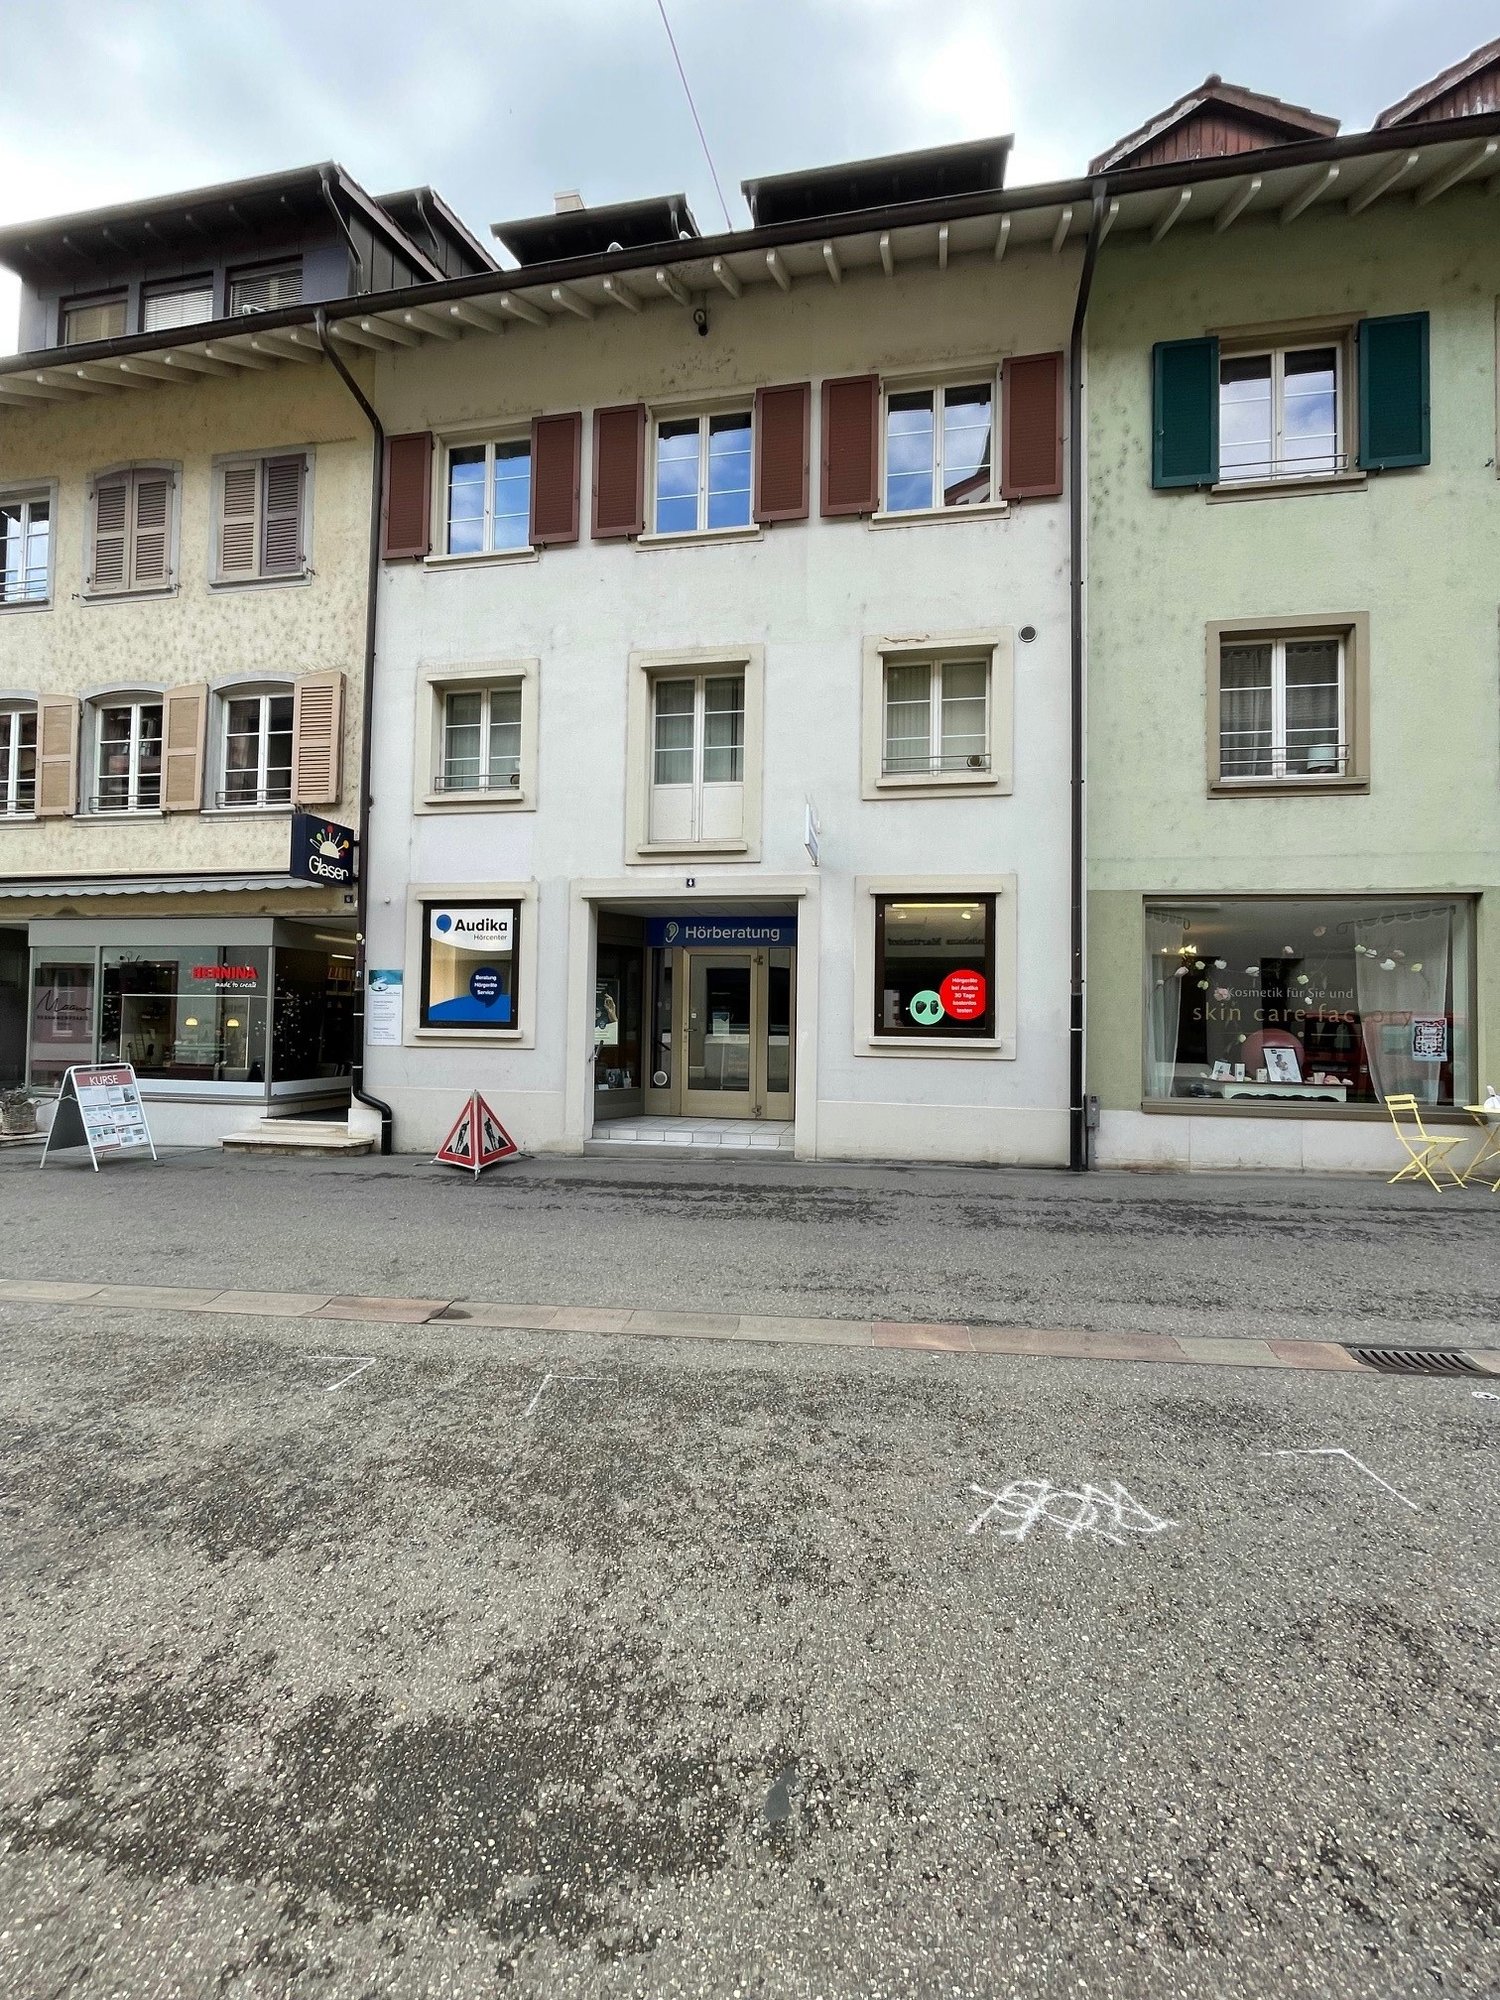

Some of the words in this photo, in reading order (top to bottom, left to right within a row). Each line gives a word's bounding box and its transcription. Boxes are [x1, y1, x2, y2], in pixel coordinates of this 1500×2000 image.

[308, 855, 349, 880] Glaser
[454, 918, 508, 931] Audika
[473, 933, 508, 941] Hörcenter
[685, 925, 780, 941] Hörberatung
[475, 974, 497, 982] Beratung
[1228, 987, 1282, 998] Kosmetik
[1286, 987, 1304, 998] für
[1308, 988, 1325, 998] Sie
[1329, 988, 1353, 999] und
[1192, 1002, 1242, 1022] skin
[1253, 1007, 1306, 1022] care
[89, 1074, 119, 1086] KURSE
